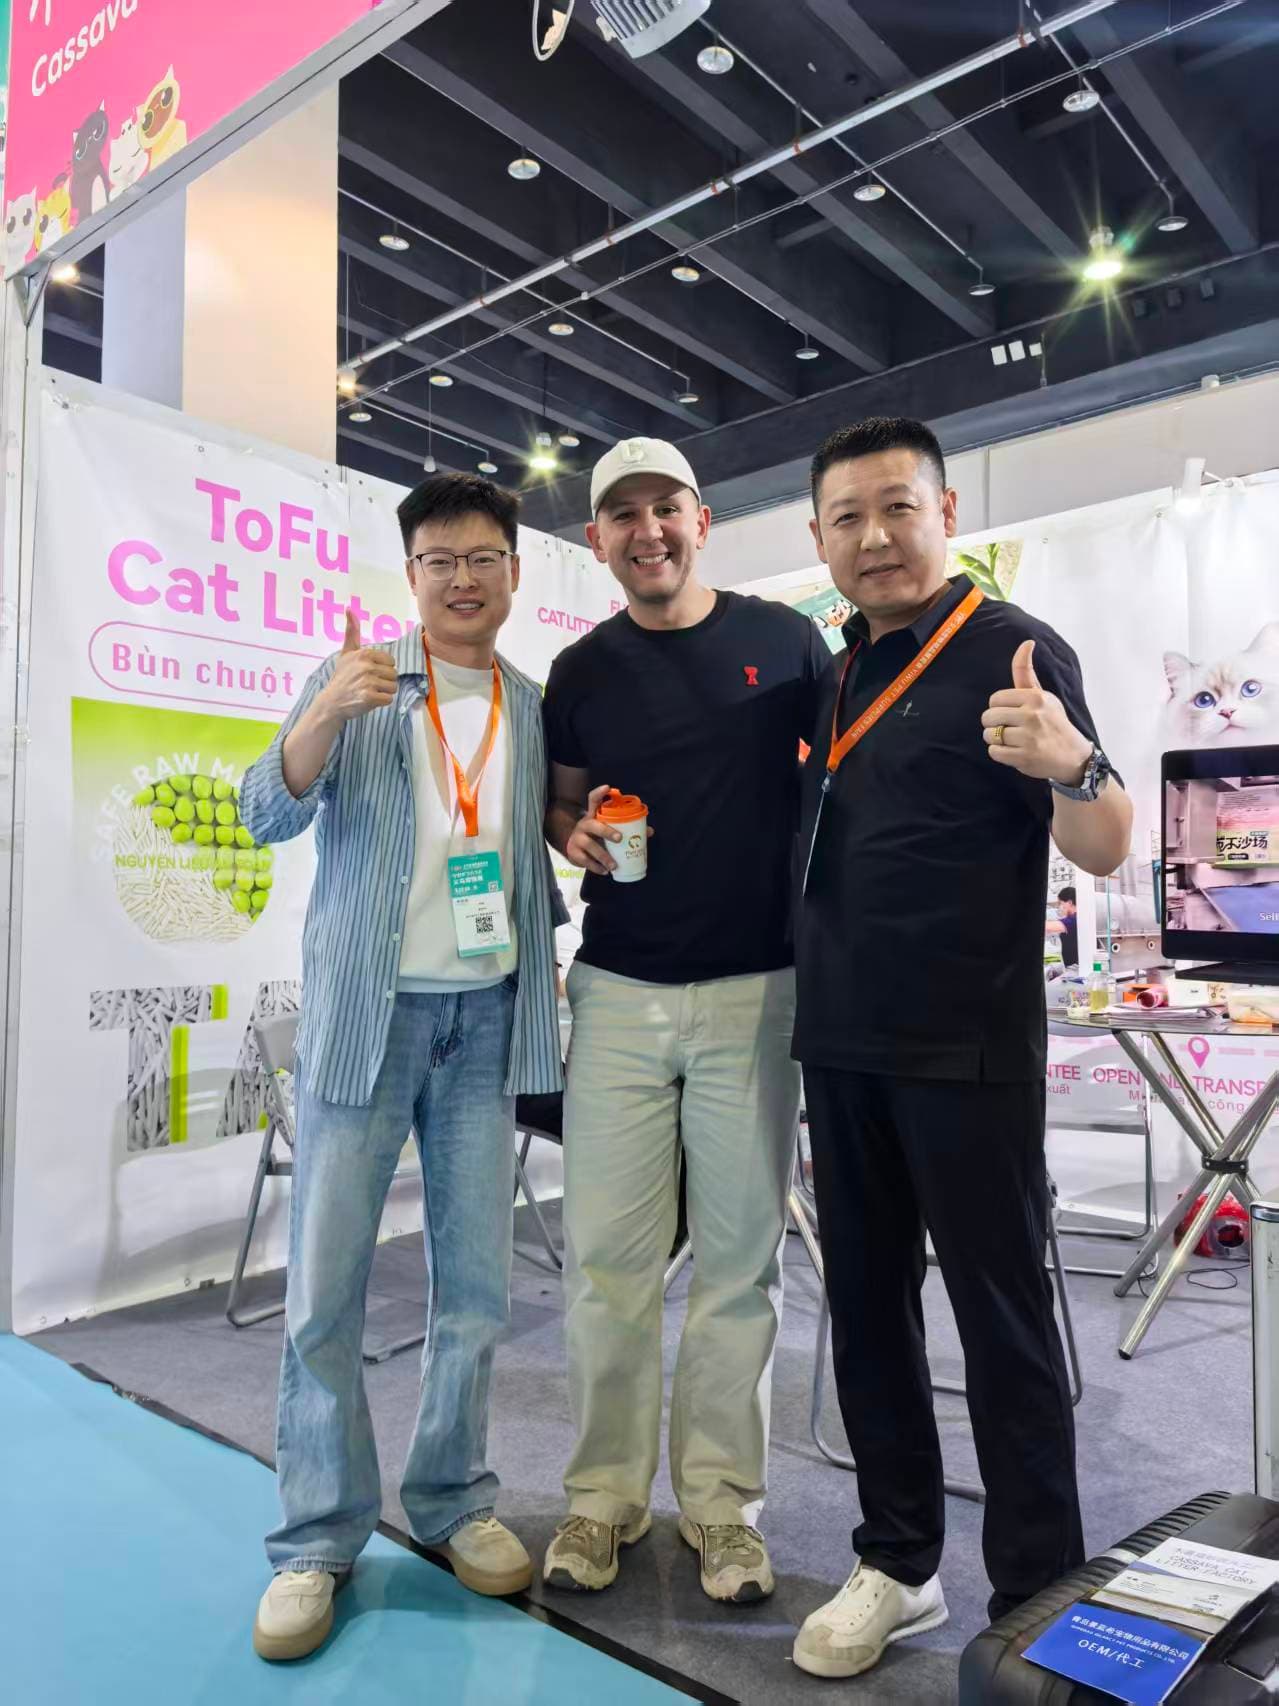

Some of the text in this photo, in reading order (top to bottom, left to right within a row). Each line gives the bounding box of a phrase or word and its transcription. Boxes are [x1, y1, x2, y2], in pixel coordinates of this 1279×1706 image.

[195, 477, 350, 575] ToFu
[107, 539, 241, 623] Cat
[111, 642, 294, 699] Bùn chuột
[131, 751, 200, 787] RAW
[1092, 1067, 1141, 1086] OPEN
